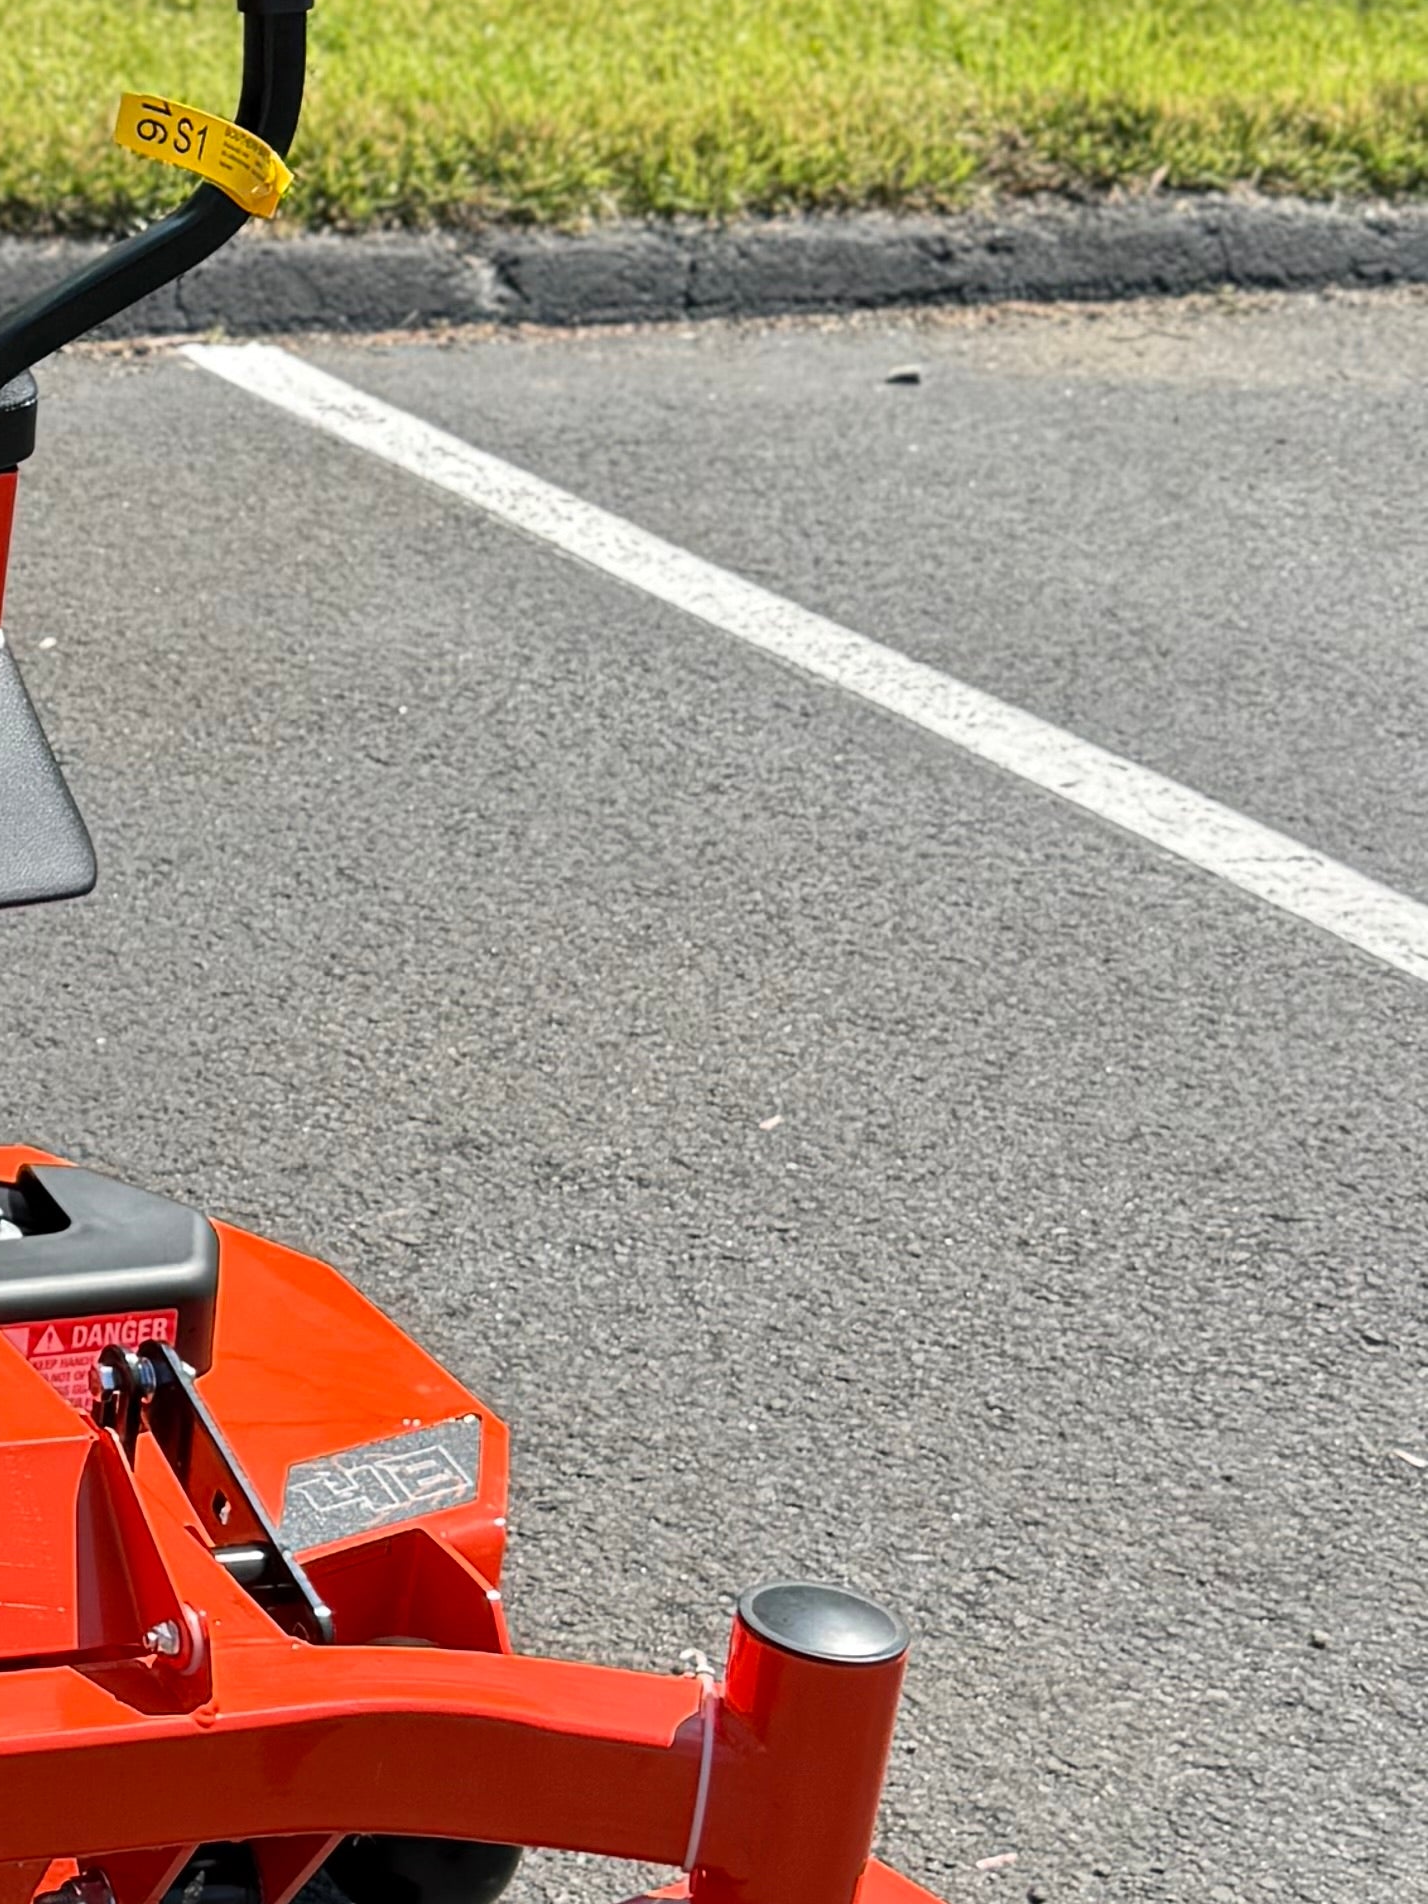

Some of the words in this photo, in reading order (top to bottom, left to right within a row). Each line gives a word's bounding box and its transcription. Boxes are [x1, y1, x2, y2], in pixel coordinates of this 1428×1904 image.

[136, 101, 172, 145] 16
[173, 117, 208, 161] S1
[70, 1317, 169, 1349] DANGER
